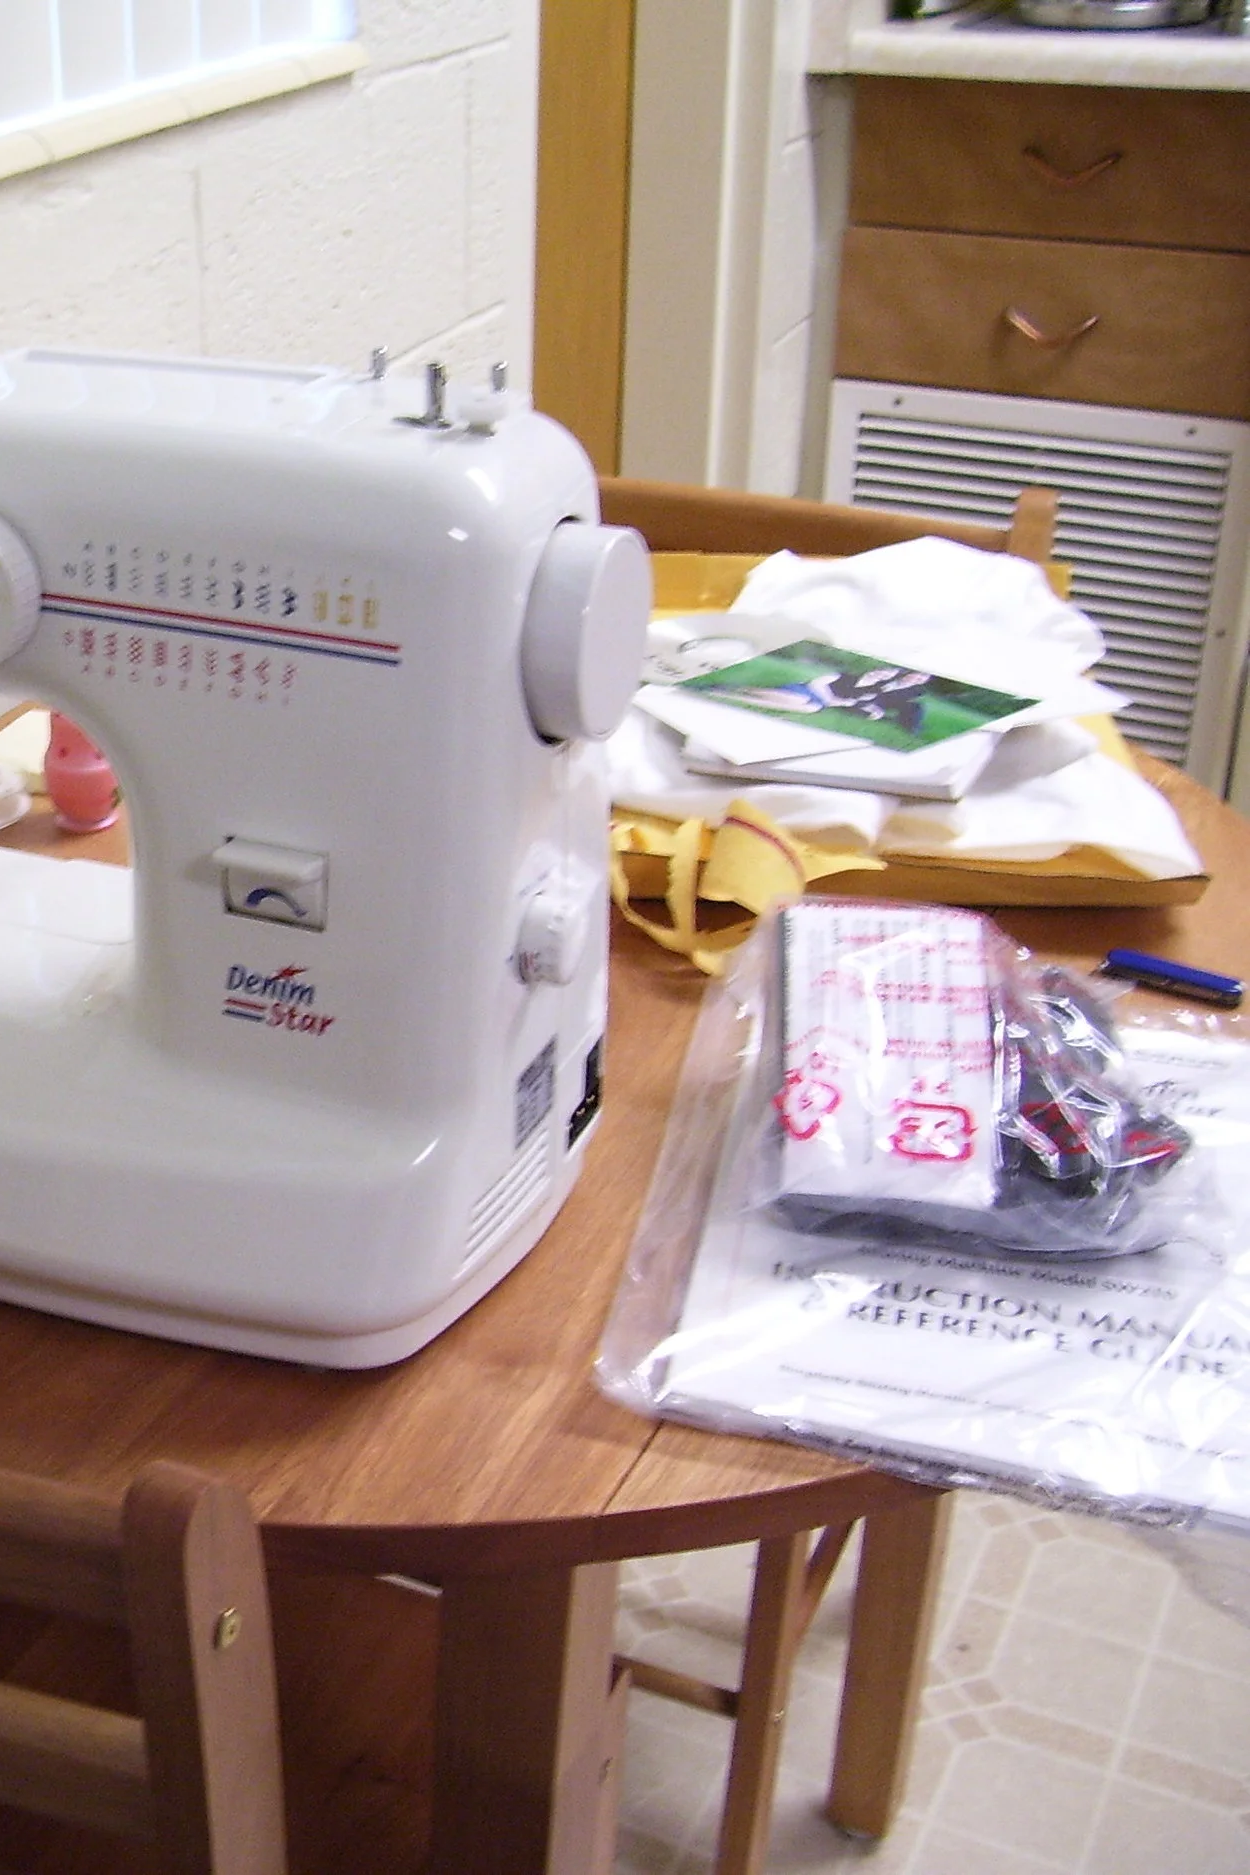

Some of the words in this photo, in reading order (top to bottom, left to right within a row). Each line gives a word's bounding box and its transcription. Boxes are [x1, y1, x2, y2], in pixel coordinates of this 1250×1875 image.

[224, 963, 317, 1007] Denim
[266, 1000, 336, 1036] Star
[771, 1260, 1062, 1324] INRUCTION
[1075, 1308, 1250, 1359] MANUA
[846, 1300, 1070, 1354] REFERENCE
